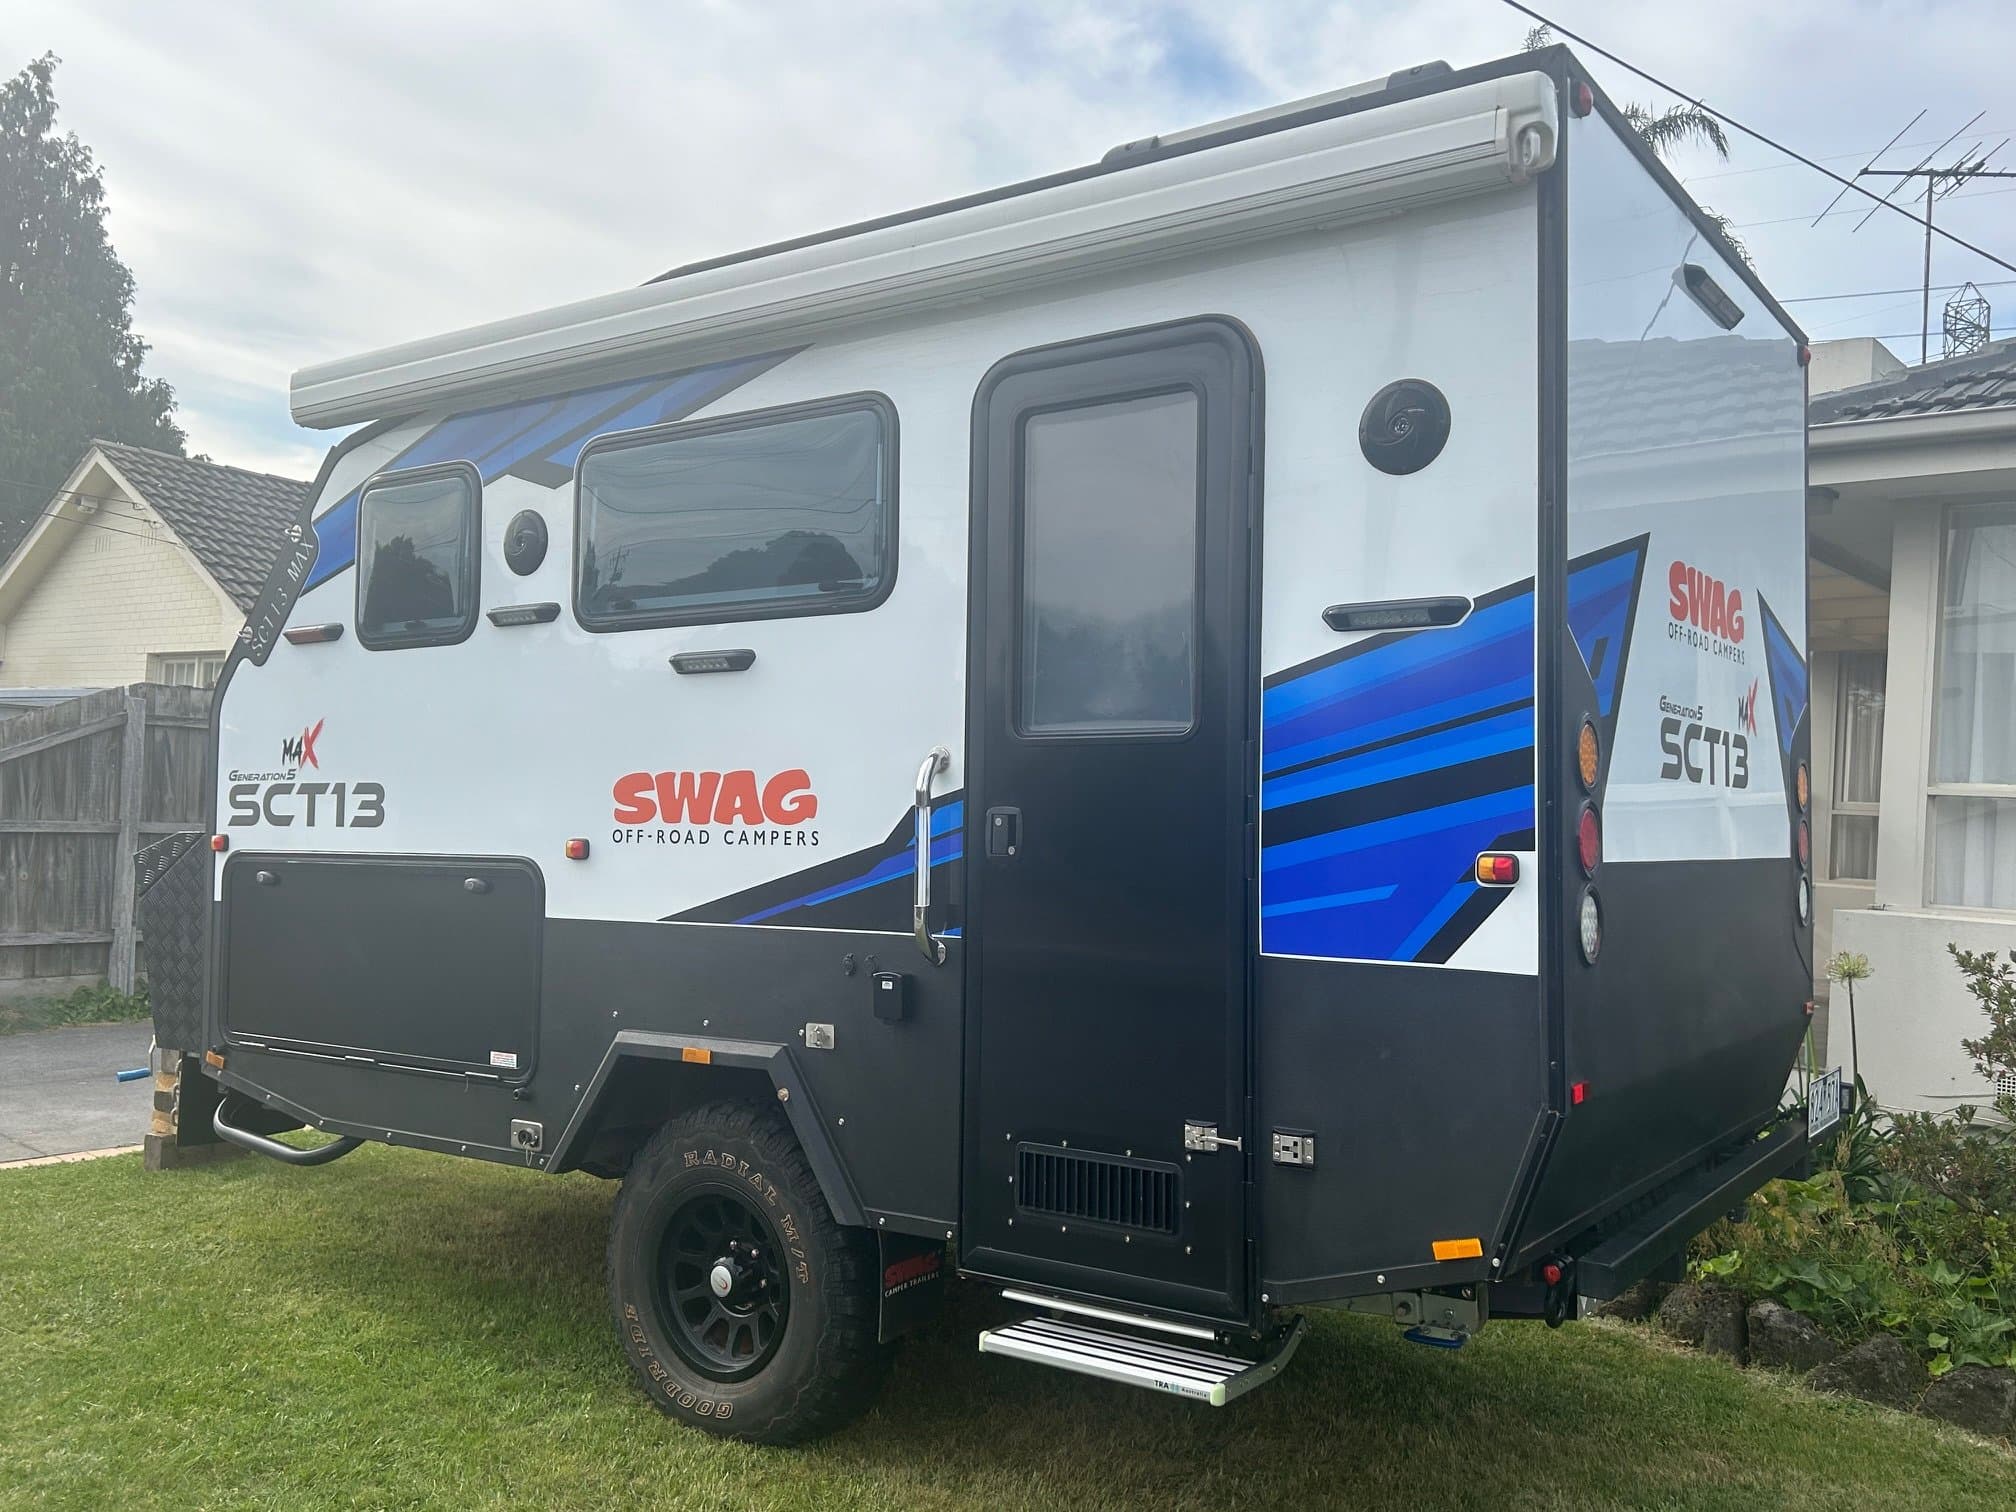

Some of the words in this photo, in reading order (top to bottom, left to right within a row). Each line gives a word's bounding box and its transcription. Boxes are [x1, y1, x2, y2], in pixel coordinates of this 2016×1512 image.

[287, 537, 314, 582] MAX
[1668, 560, 1745, 644] SWAG
[1668, 621, 1710, 652] OFF-ROAD
[1713, 640, 1746, 665] CAMPERS
[1738, 677, 1758, 737] MAX
[281, 716, 325, 769] MAX
[1660, 716, 1749, 789] SCT13
[227, 781, 386, 828] SCT13
[612, 768, 818, 826] SWAG
[611, 828, 711, 845] OFF-ROAD
[723, 829, 820, 847] CAMPERS
[683, 1149, 777, 1206] RADIAL
[780, 1213, 809, 1284] M/T
[884, 1281, 908, 1298] CAMPER
[623, 1302, 734, 1419] GOODRIDE
[1153, 1379, 1170, 1390] TRA
[1181, 1387, 1208, 1398] Australia
